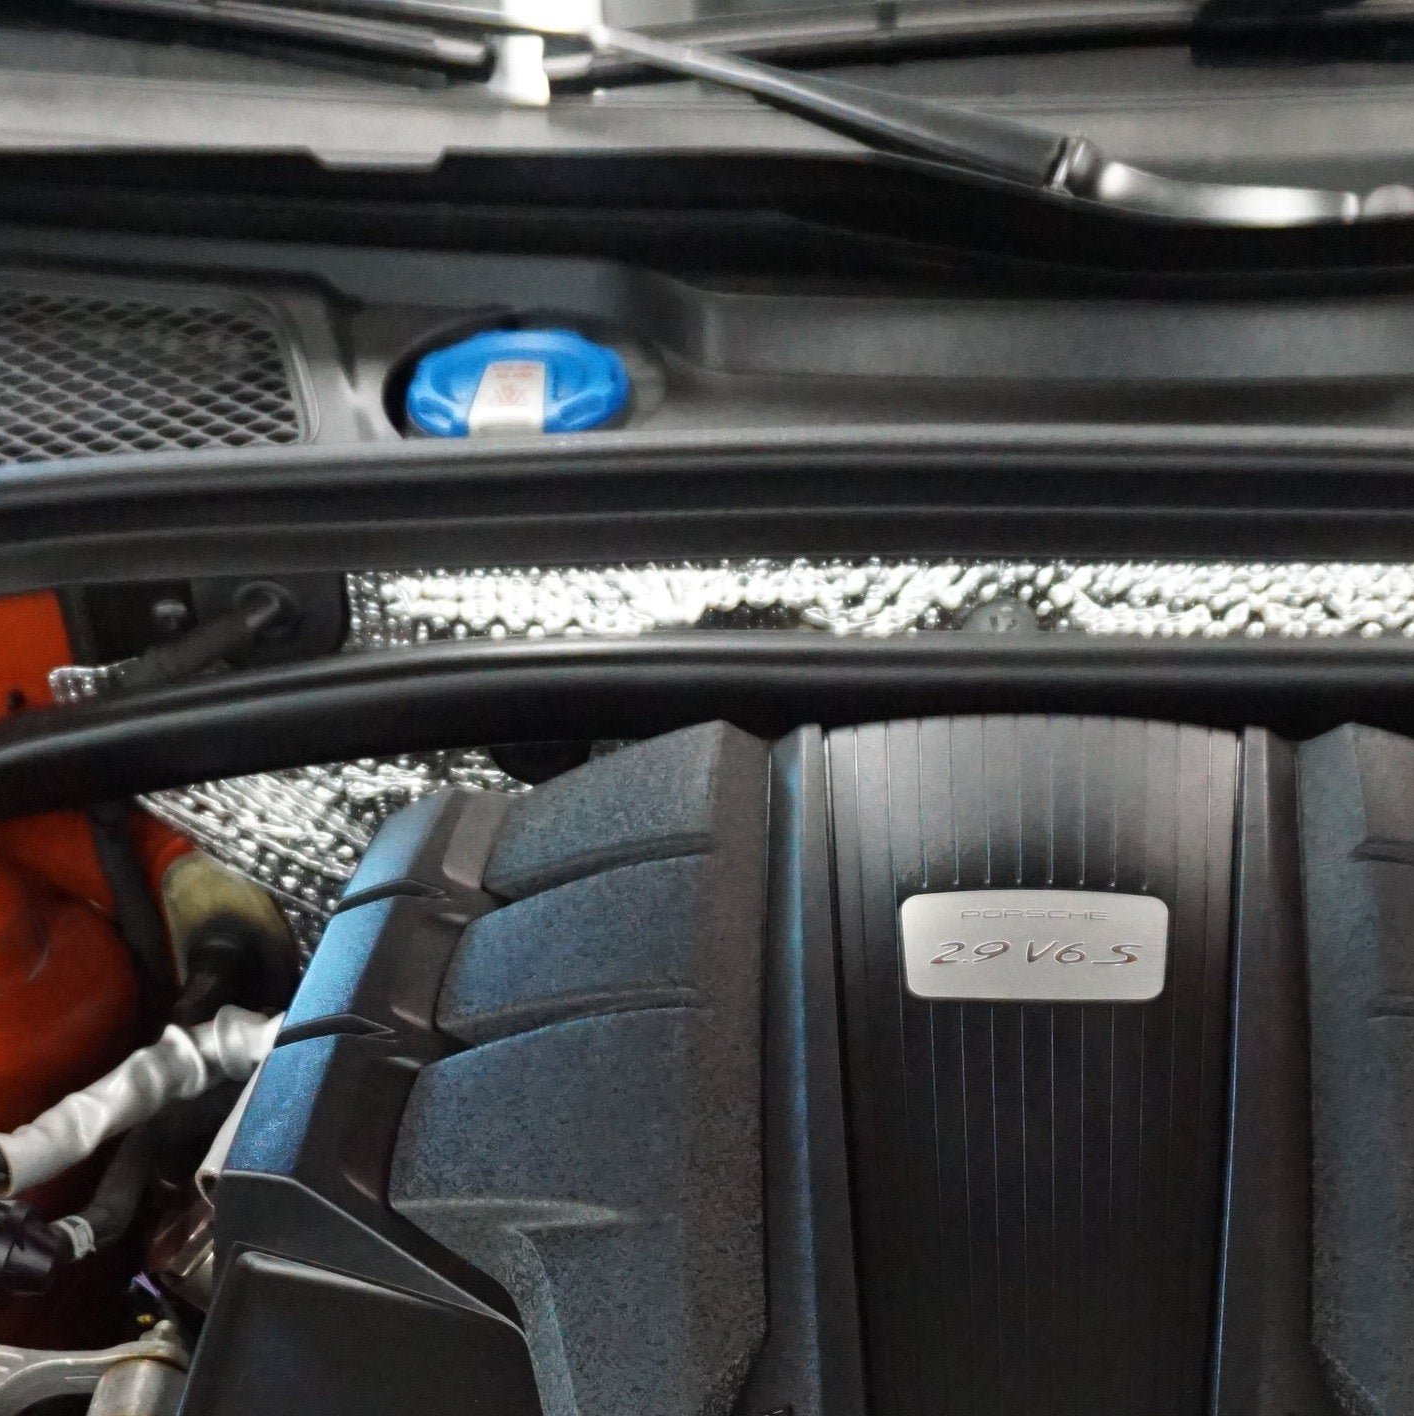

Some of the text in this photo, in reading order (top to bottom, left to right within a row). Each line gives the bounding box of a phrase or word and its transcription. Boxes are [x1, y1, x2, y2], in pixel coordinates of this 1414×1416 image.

[961, 908, 1110, 920] PORSCHE
[929, 940, 1143, 966] 2.9 V6 S
